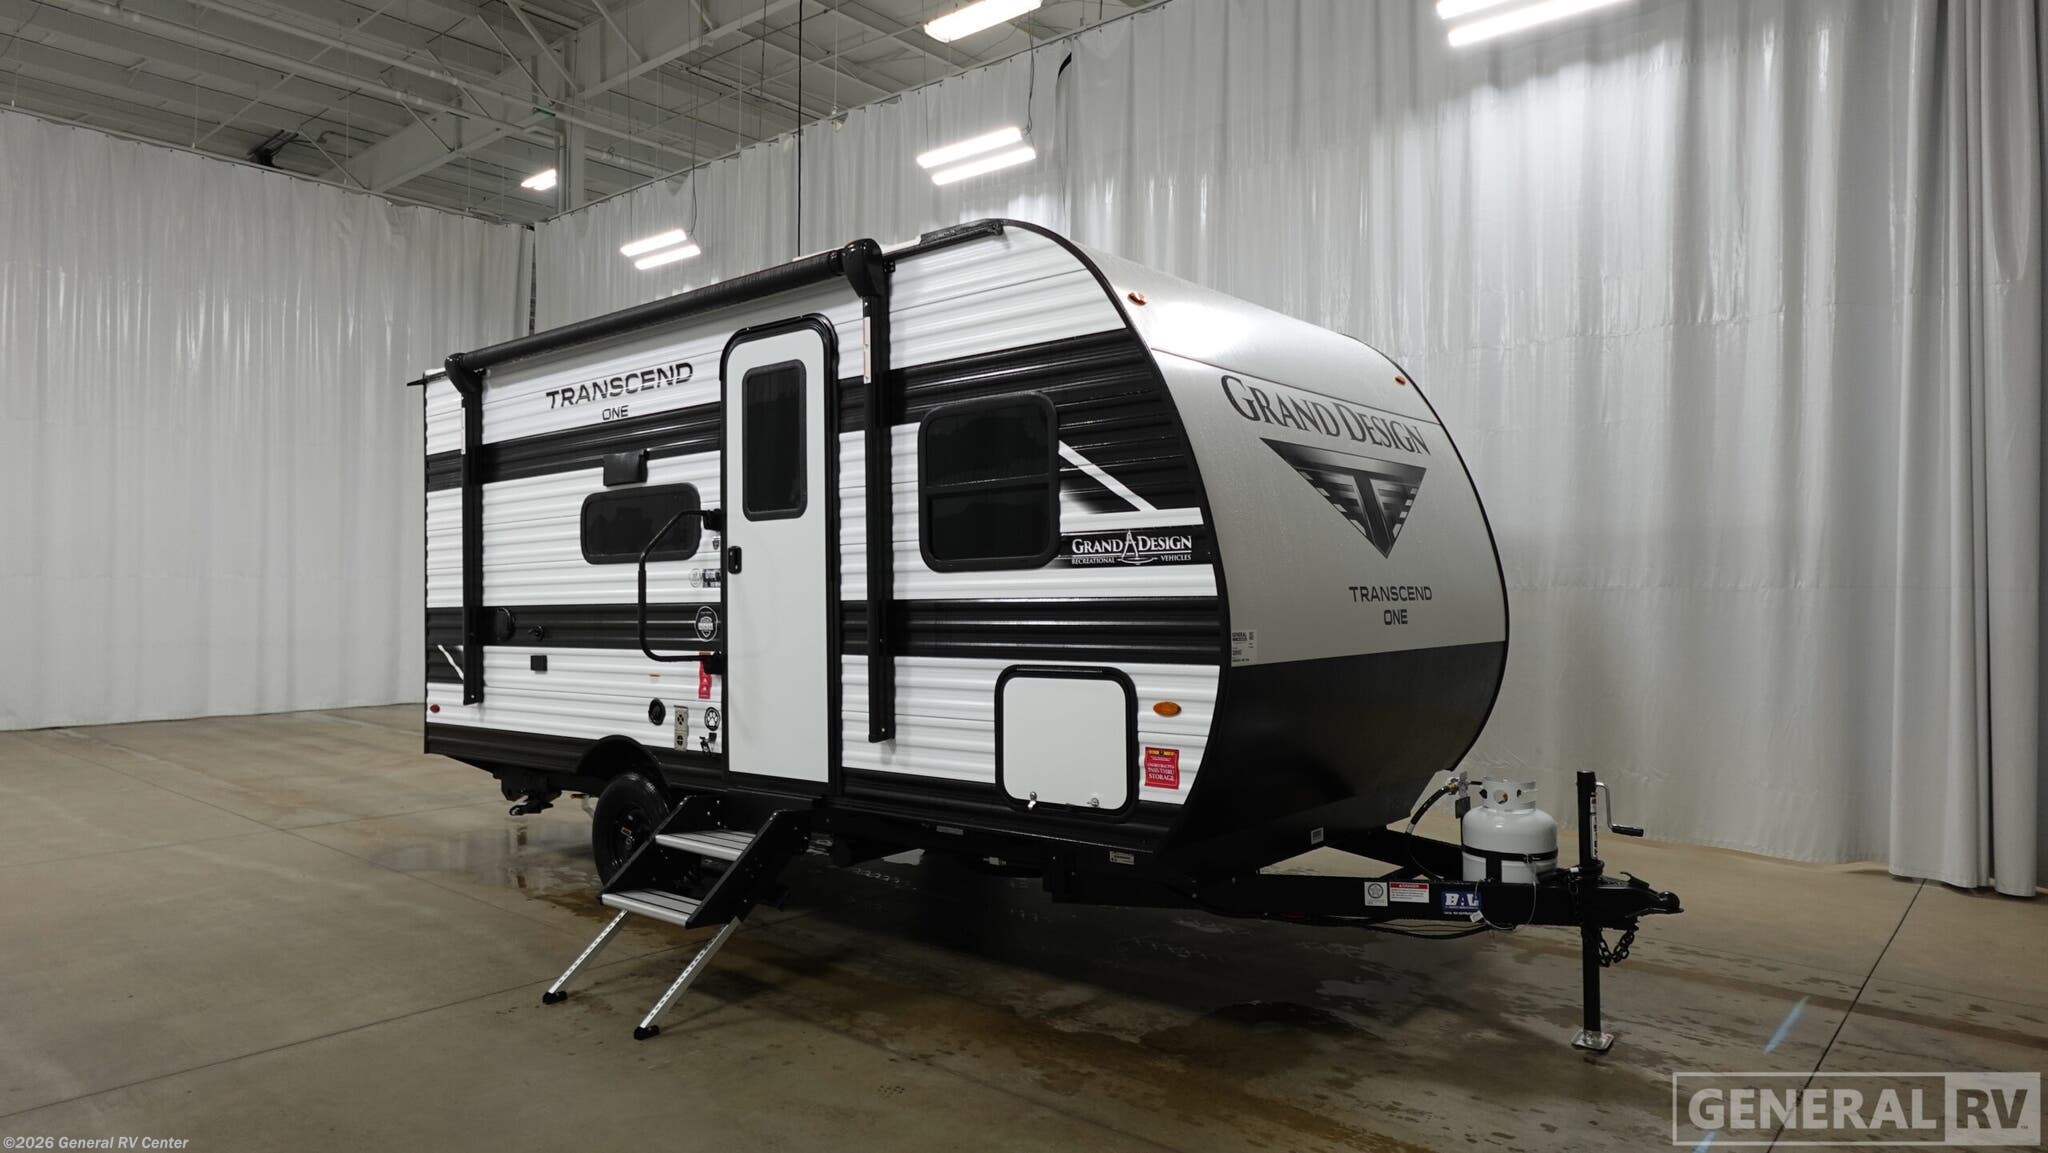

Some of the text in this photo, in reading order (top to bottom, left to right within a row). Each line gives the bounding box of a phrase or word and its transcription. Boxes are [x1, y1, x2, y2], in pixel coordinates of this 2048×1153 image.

[546, 362, 693, 409] TRANSCEND
[602, 405, 629, 421] ONE
[1221, 375, 1431, 456] GRAND DESIGN
[1072, 535, 1192, 554] GRAND DESIGN
[1071, 553, 1192, 565] RECREATIONAL VEHICLES
[1348, 585, 1433, 602] TRANSCEND
[1383, 609, 1408, 626] ONE
